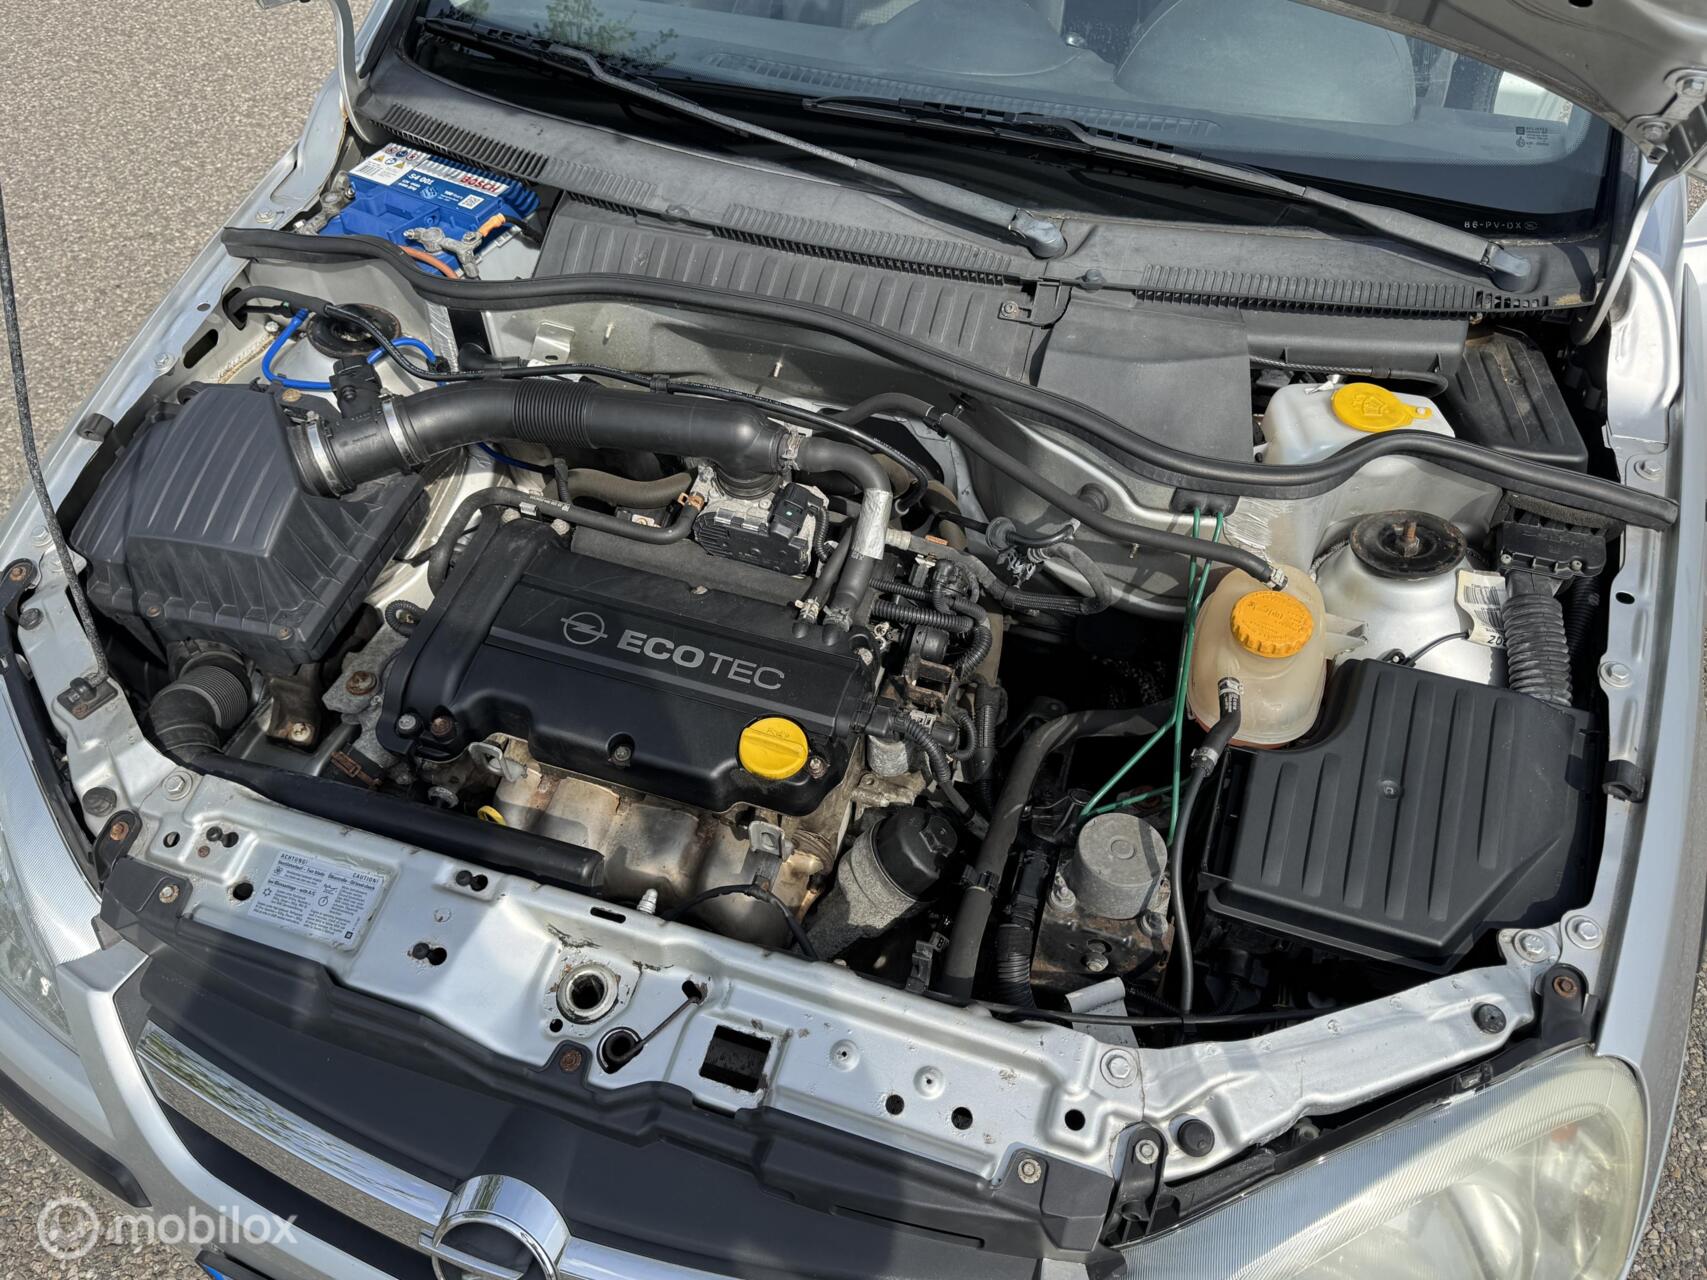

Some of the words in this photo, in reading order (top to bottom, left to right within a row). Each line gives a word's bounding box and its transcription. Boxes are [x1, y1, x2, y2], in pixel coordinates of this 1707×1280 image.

[461, 175, 502, 193] BOSCH
[616, 629, 785, 690] ECOTEC
[352, 872, 379, 884] CAUTION!
